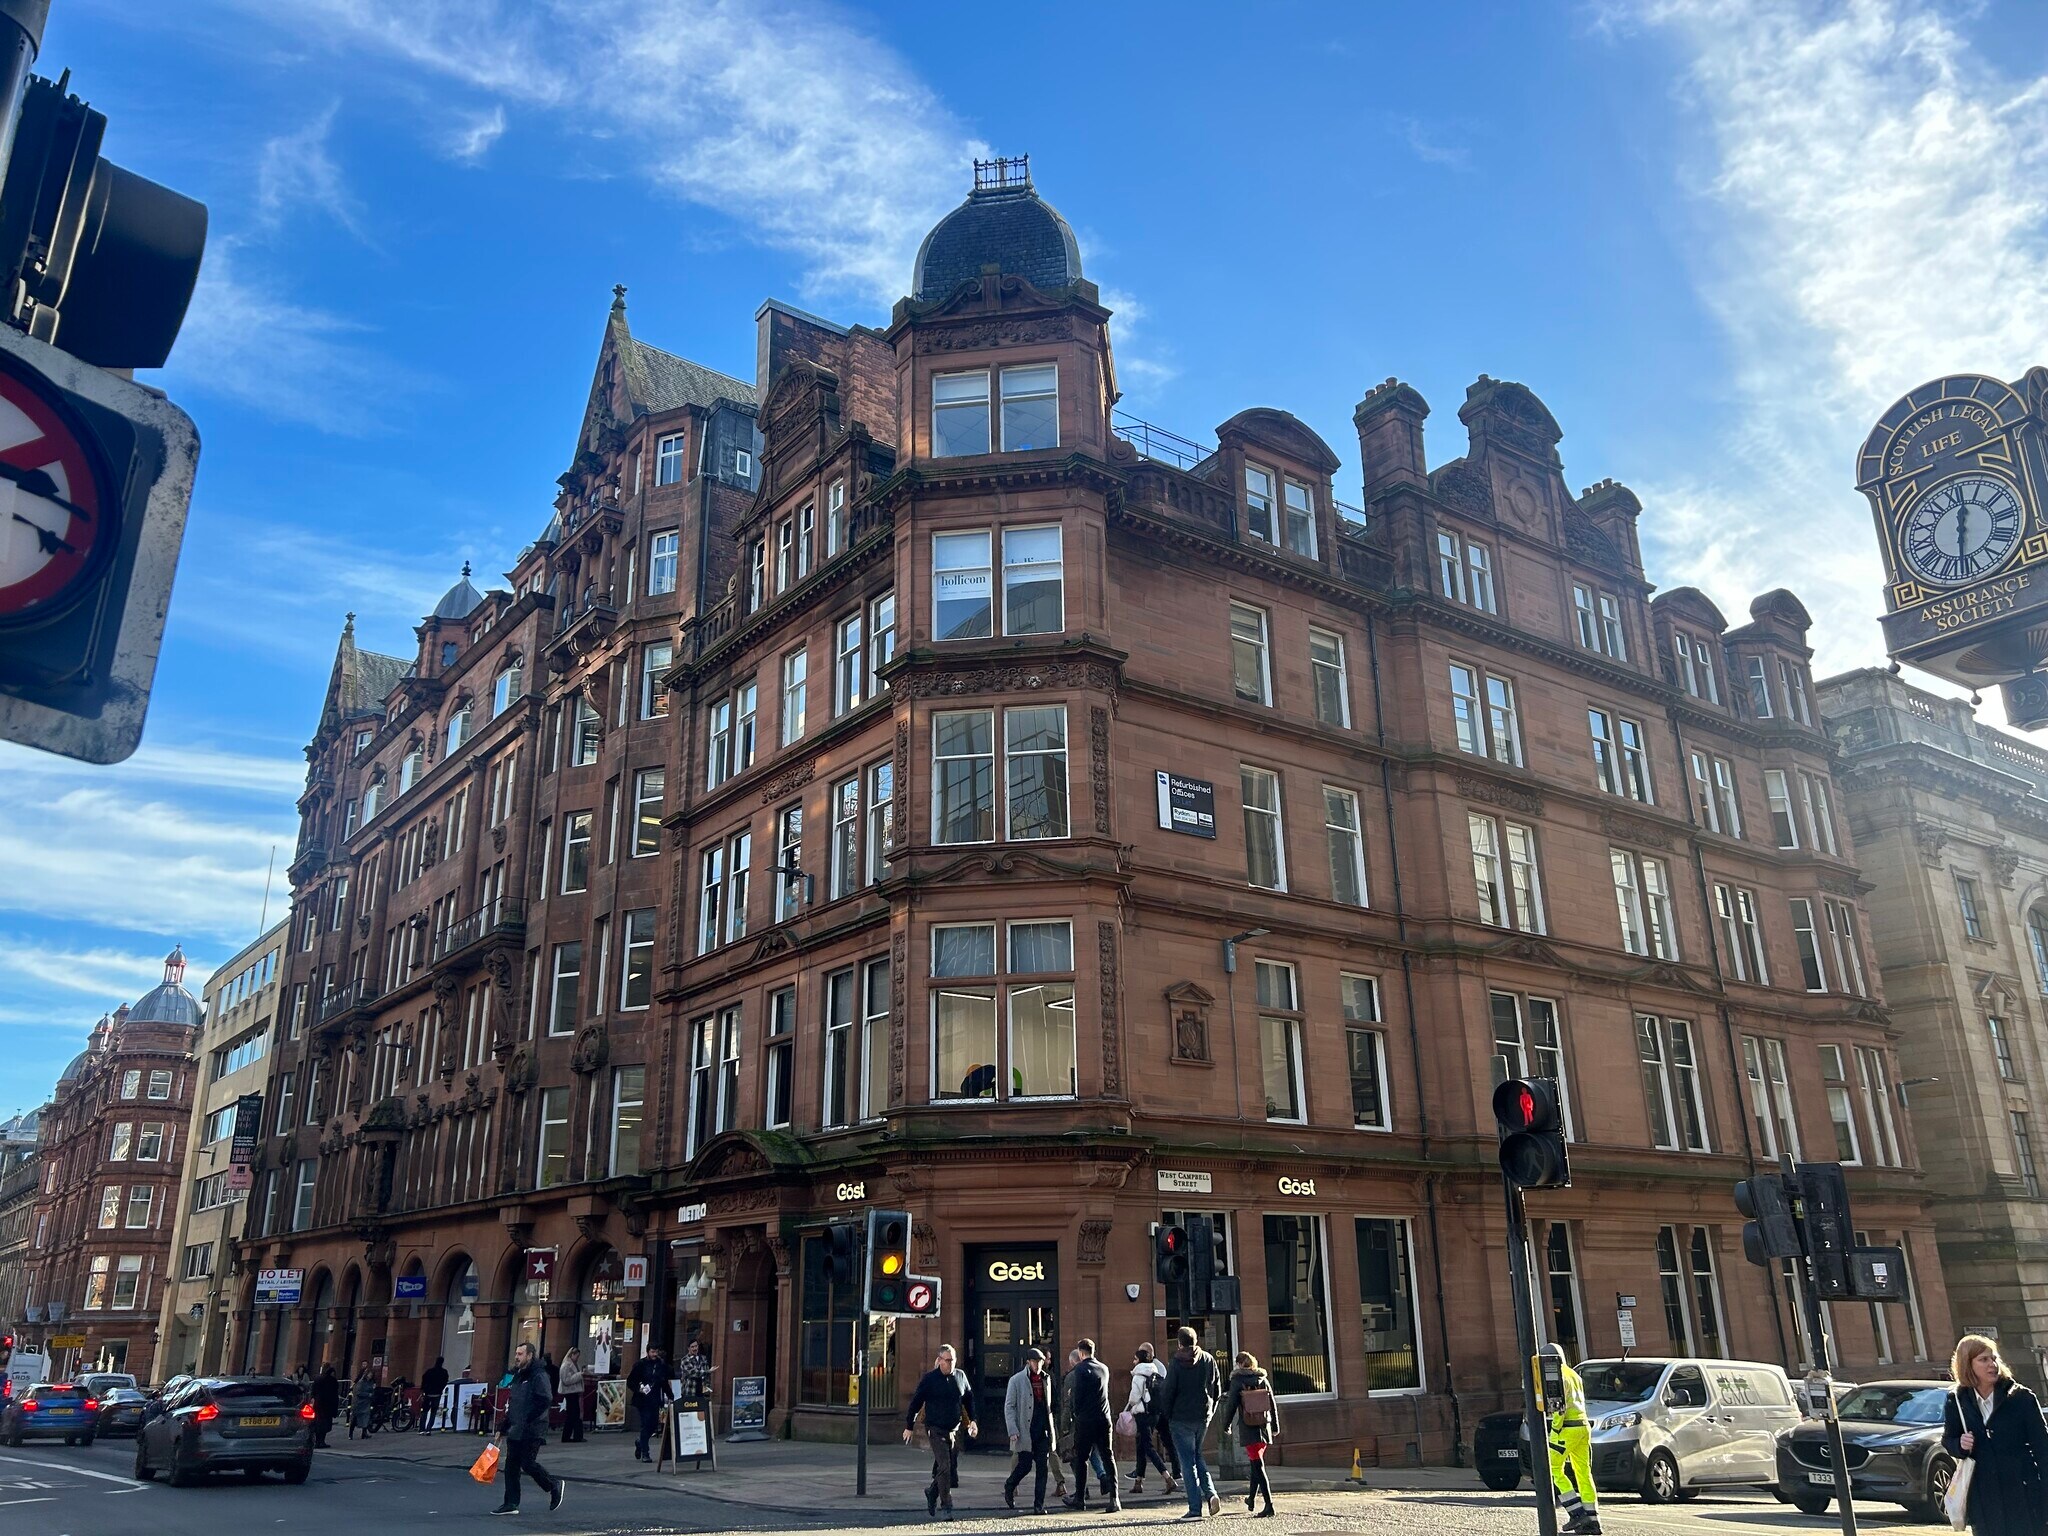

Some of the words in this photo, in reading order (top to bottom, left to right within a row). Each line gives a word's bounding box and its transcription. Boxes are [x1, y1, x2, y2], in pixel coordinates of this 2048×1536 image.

[1889, 407, 1944, 476] SCOTTISH
[1949, 404, 2000, 438] LEGAL
[1921, 430, 1963, 459] LIFE
[941, 574, 986, 586] hollicom
[1920, 573, 2030, 623] ASSURANCE
[1937, 594, 2017, 631] SOCIETY
[1171, 778, 1212, 794] Refurbished
[1171, 787, 1196, 799] Offices
[1173, 1179, 1197, 1187] STREET
[1178, 1172, 1209, 1181] CAMPBELL
[678, 1202, 707, 1223] METRO
[259, 1270, 276, 1279] TO
[280, 1269, 302, 1279] LET
[1720, 1387, 1756, 1405] GMC
